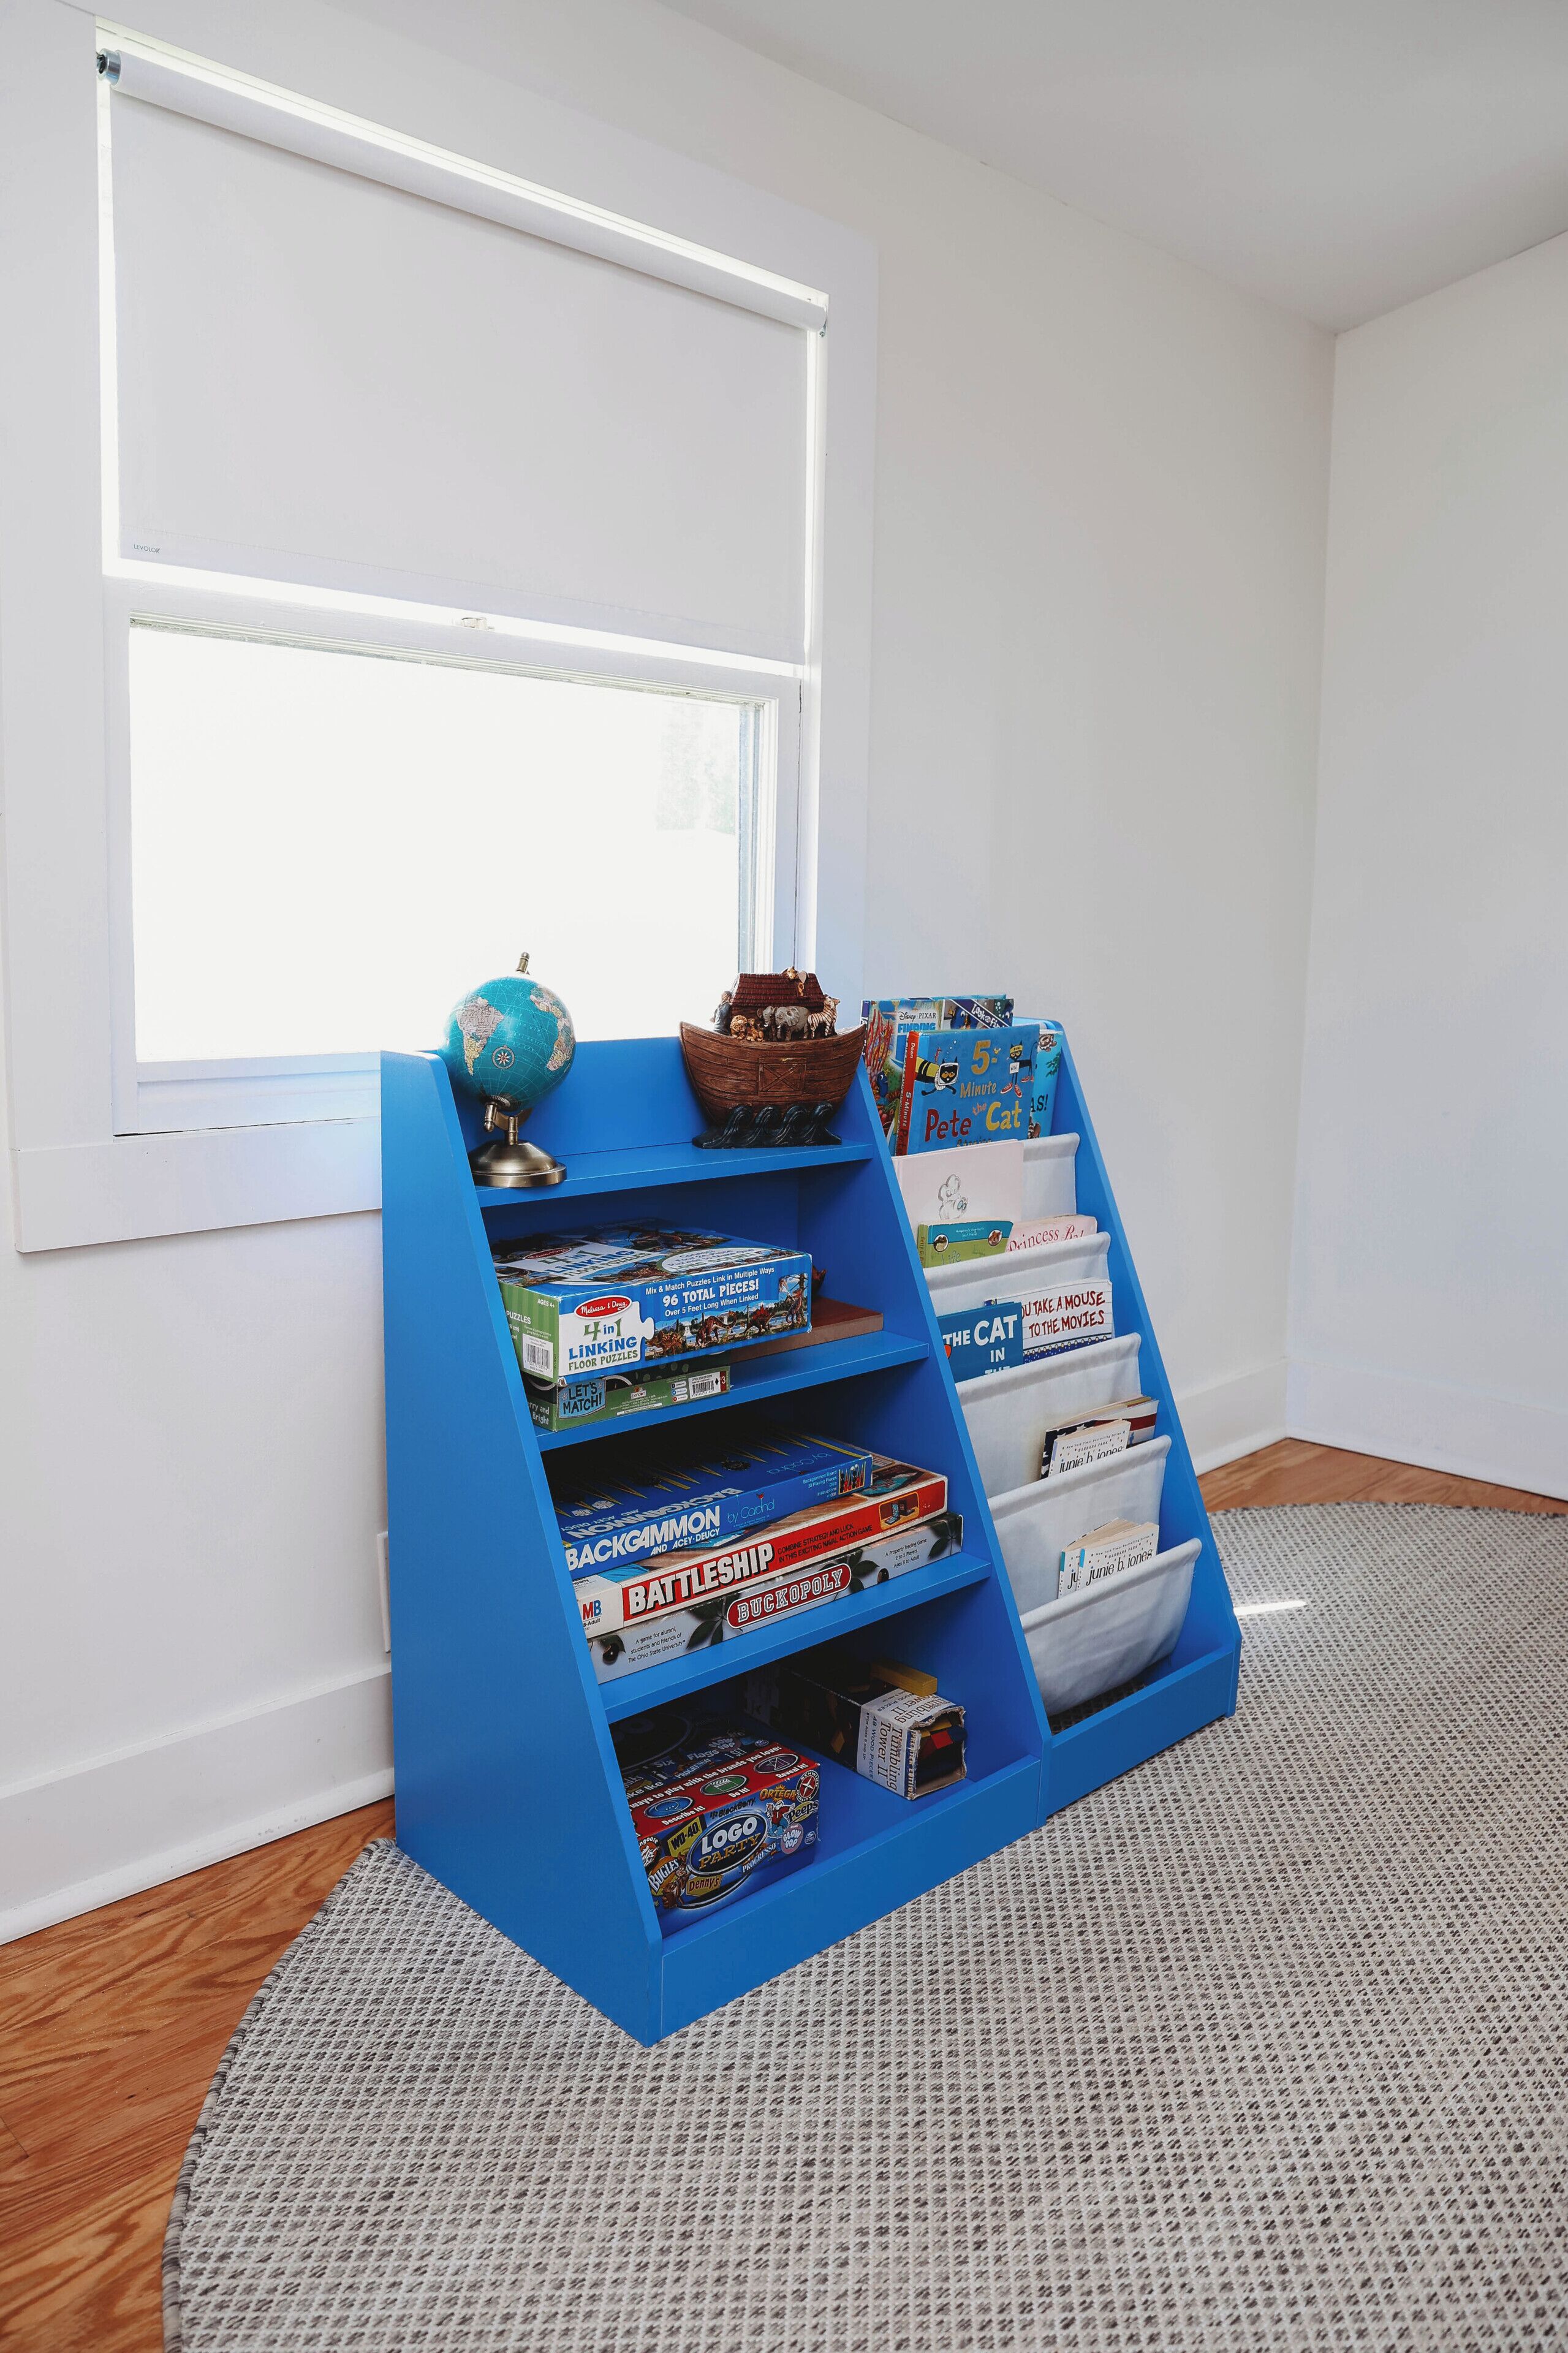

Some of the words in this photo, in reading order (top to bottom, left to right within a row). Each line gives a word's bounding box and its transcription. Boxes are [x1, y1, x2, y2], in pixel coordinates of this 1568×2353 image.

[134, 544, 160, 553] LEVOLOR
[898, 1011, 916, 1022] Disney
[971, 1003, 985, 1021] Look
[898, 1022, 936, 1033] FINDING
[960, 1080, 997, 1099] Minute
[925, 1108, 972, 1143] Pete
[972, 1102, 987, 1116] the
[986, 1101, 1022, 1131] Cat
[646, 1286, 657, 1295] Mix
[665, 1281, 685, 1292] Match
[686, 1278, 711, 1289] Puzzles
[712, 1274, 725, 1284] Link
[734, 1269, 758, 1281] Multiple
[759, 1266, 775, 1275] Ways
[537, 1298, 549, 1307] AGES
[662, 1294, 679, 1308] 96
[682, 1286, 716, 1304] TOTAL
[665, 1308, 680, 1317] Over
[703, 1301, 719, 1310] Long
[720, 1298, 738, 1306] When
[739, 1292, 759, 1303] Linked
[1032, 1298, 1055, 1317] TAKE
[1056, 1295, 1063, 1311] A
[1064, 1290, 1106, 1311] MOUSE
[506, 1310, 531, 1325] PUZZLES
[581, 1305, 605, 1316] Melissa
[583, 1320, 602, 1342] 4
[603, 1324, 615, 1335] in
[614, 1317, 623, 1337] 1
[942, 1329, 971, 1347] THE
[974, 1314, 1018, 1346] CAT
[1029, 1322, 1041, 1338] TO
[1041, 1318, 1060, 1335] THE
[1061, 1309, 1105, 1332] MOVIES
[568, 1357, 597, 1371] FLOOR
[600, 1349, 638, 1365] PUZZLES
[990, 1347, 1005, 1363] IN
[568, 1382, 598, 1400] LET'S
[539, 1406, 550, 1415] and
[562, 1392, 602, 1414] MATCH!
[532, 1412, 550, 1425] Bright
[1078, 1444, 1097, 1452] BARBARA
[566, 1487, 744, 1539] BACKGAMMON
[727, 1512, 738, 1523] by
[565, 1506, 721, 1572] BACKGAMMON
[777, 1542, 803, 1555] COMBINE
[803, 1532, 829, 1546] STRATEGY
[829, 1528, 839, 1537] AND
[839, 1523, 854, 1533] LUCK
[785, 1551, 798, 1561] THIS
[798, 1542, 822, 1556] EXCITING
[822, 1537, 838, 1548] NAVAL
[839, 1531, 858, 1541] ACTION
[858, 1525, 873, 1536] GAME
[1123, 1539, 1140, 1548] Bestselling
[650, 1544, 668, 1556] AND
[889, 1547, 904, 1555] Property
[1108, 1549, 1127, 1558] BARBARA
[1085, 1563, 1115, 1586] junie
[1117, 1556, 1125, 1572] b.
[1127, 1548, 1153, 1569] jones
[627, 1543, 775, 1616] BATTLESHIP
[737, 1568, 843, 1623] BUCKOPOLY
[582, 1599, 602, 1621] MB
[631, 1643, 650, 1654] students
[661, 1635, 676, 1644] friends
[640, 1635, 653, 1644] game
[661, 1626, 676, 1636] alumni,
[662, 1641, 683, 1652] University
[872, 1716, 877, 1727] 48
[877, 1721, 891, 1763] Tower
[653, 1758, 675, 1768] Six
[686, 1748, 720, 1761] Flags
[888, 1727, 903, 1791] Tumbling
[630, 1796, 651, 1808] ways
[664, 1784, 686, 1797] play
[683, 1776, 705, 1787] with
[703, 1771, 719, 1781] the
[717, 1759, 748, 1774] brands
[746, 1754, 762, 1763] you
[762, 1746, 782, 1756] love:
[775, 1767, 798, 1778] Reveal
[800, 1771, 819, 1787] SCHWINN
[877, 1764, 888, 1779] II
[759, 1789, 797, 1802] ORTEGA
[718, 1797, 755, 1817] BlackBerry
[787, 1800, 819, 1822] Peeps
[661, 1809, 696, 1826] Describe
[670, 1821, 701, 1851] WD-40
[701, 1816, 757, 1855] LOGO
[782, 1829, 801, 1842] BLOW
[785, 1838, 798, 1849] POP
[699, 1832, 761, 1870] PARTY
[741, 1842, 776, 1873] PROGRESSO
[647, 1858, 680, 1892] BUGLES
[688, 1876, 720, 1892] Denny's
